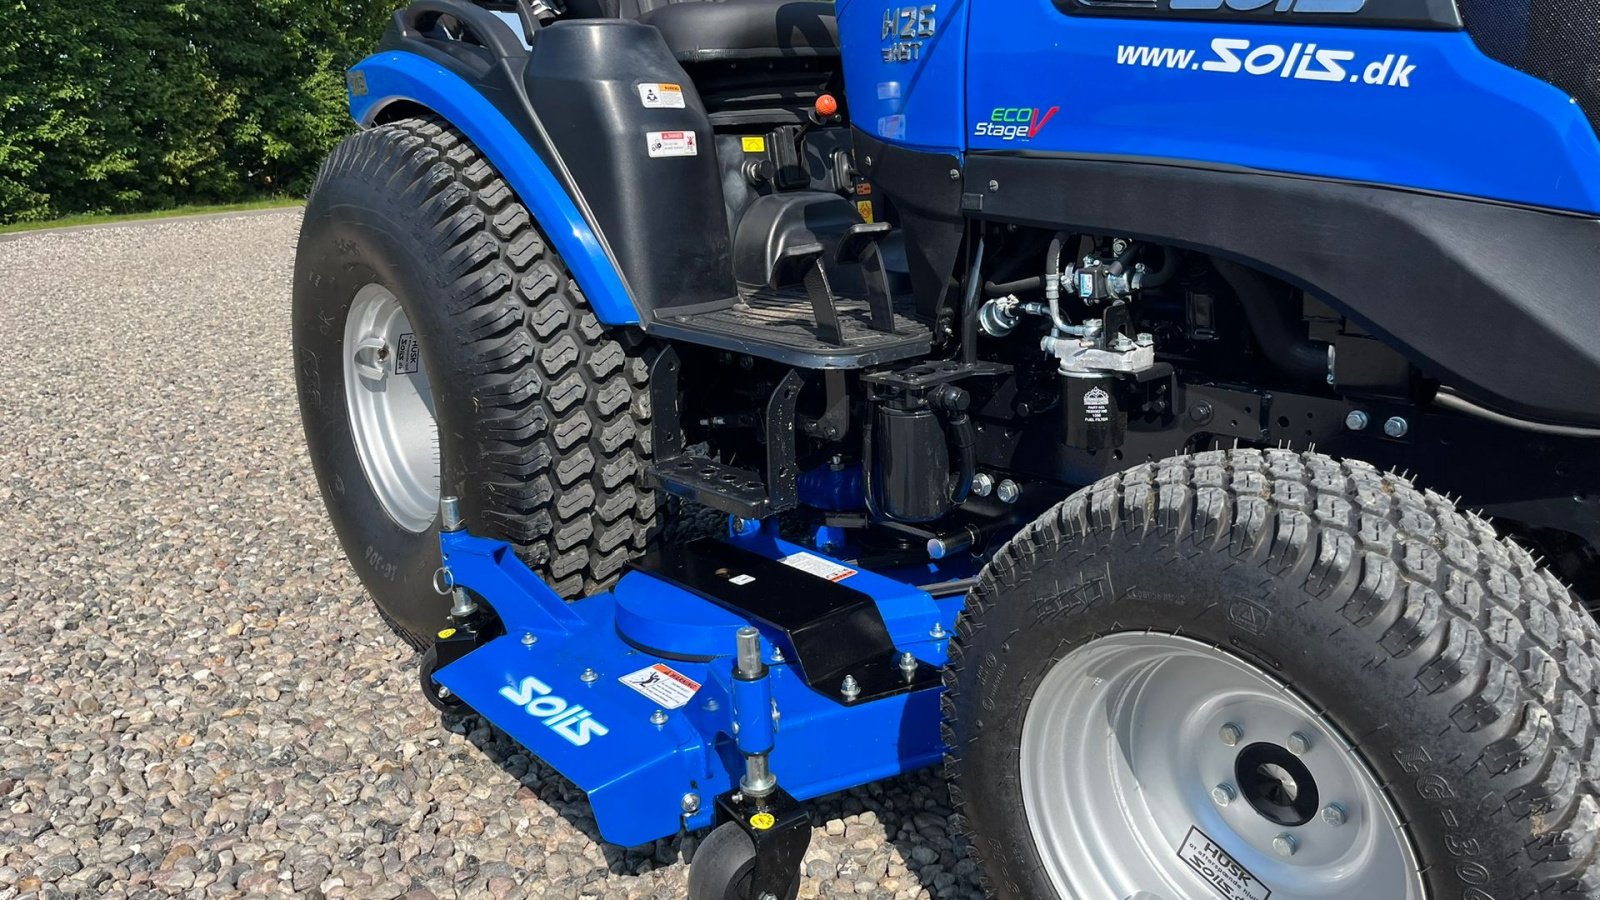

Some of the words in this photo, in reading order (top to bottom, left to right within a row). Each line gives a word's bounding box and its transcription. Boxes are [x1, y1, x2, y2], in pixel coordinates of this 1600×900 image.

[882, 4, 936, 41] H26
[991, 107, 1033, 122] ECO
[1204, 842, 1251, 887] HUSK
